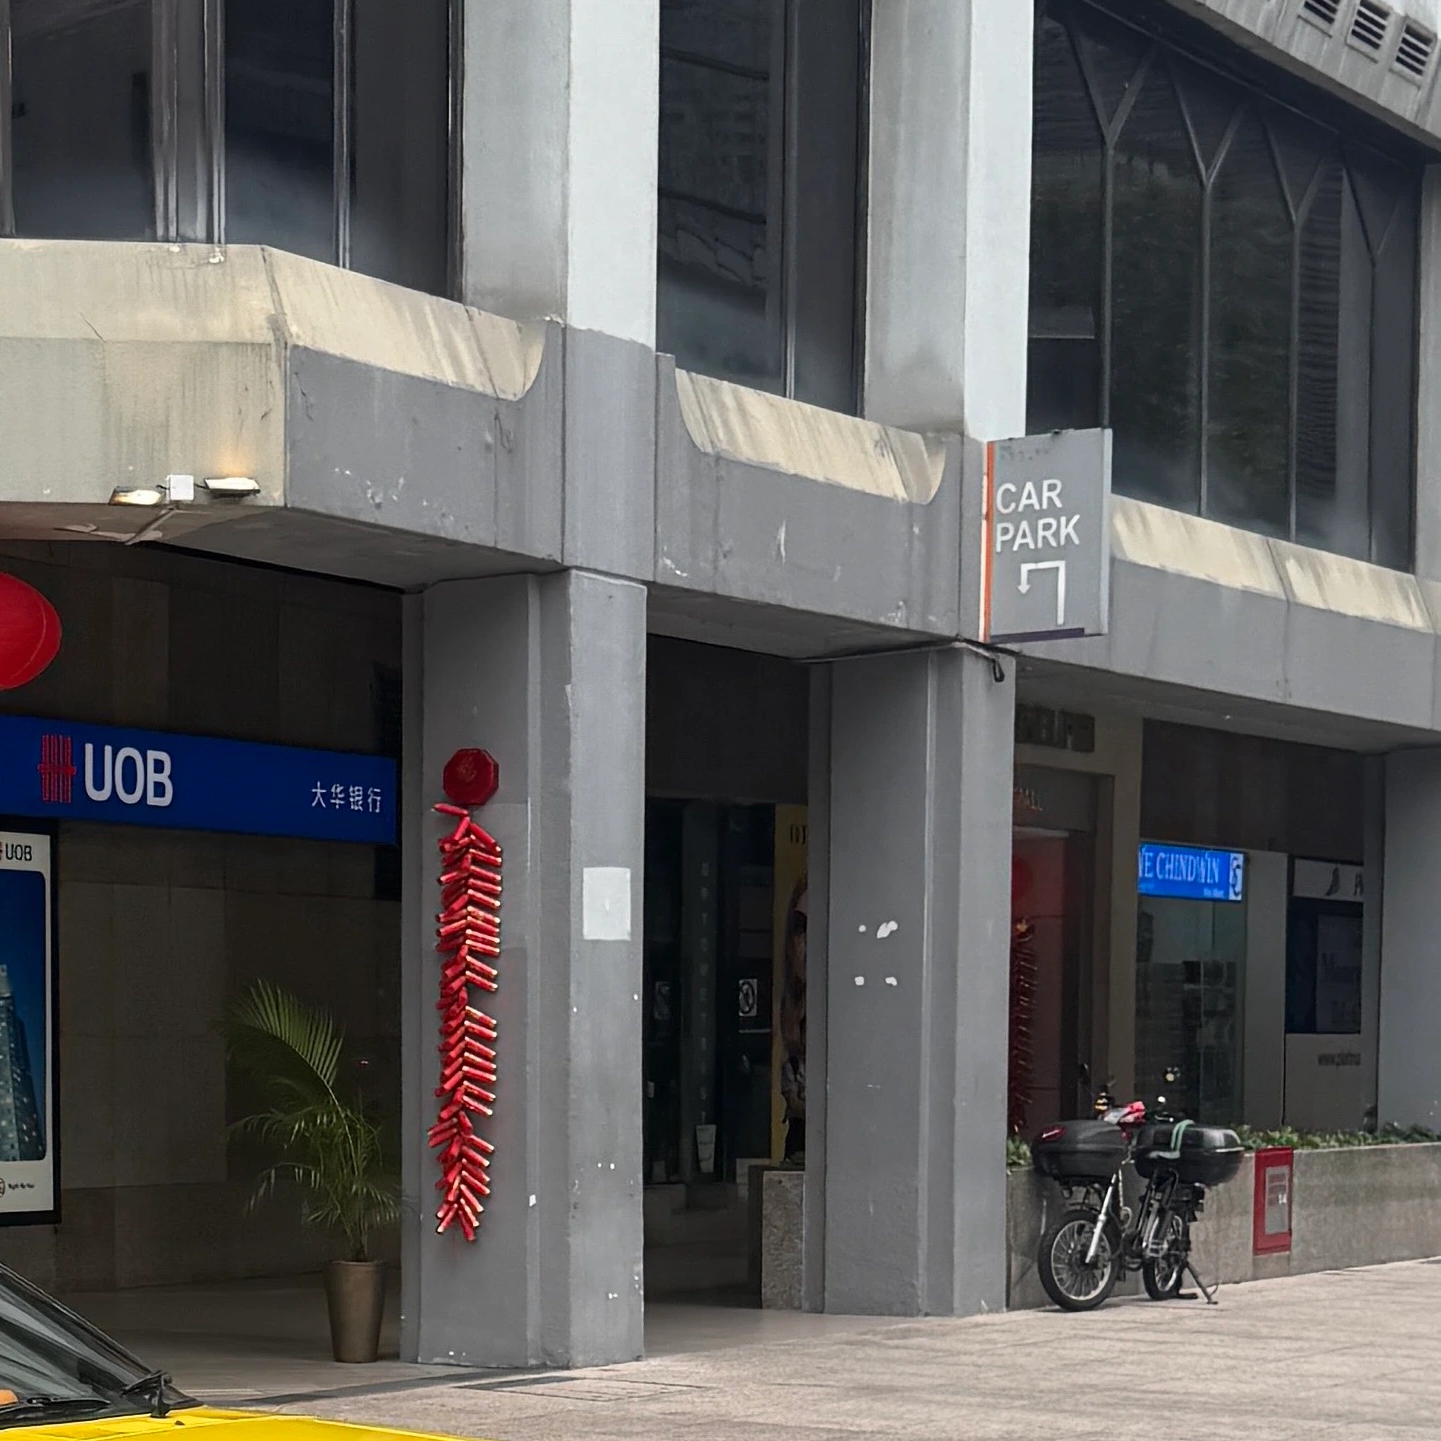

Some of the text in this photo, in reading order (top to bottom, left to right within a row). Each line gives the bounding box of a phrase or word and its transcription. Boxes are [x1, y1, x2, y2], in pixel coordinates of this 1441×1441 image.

[996, 479, 1063, 514] CAR
[996, 514, 1081, 553] PARK
[85, 743, 173, 806] UOB
[312, 781, 382, 813] 大华银行
[5, 843, 33, 861] UOB
[1156, 851, 1221, 883] CHINDWIN
